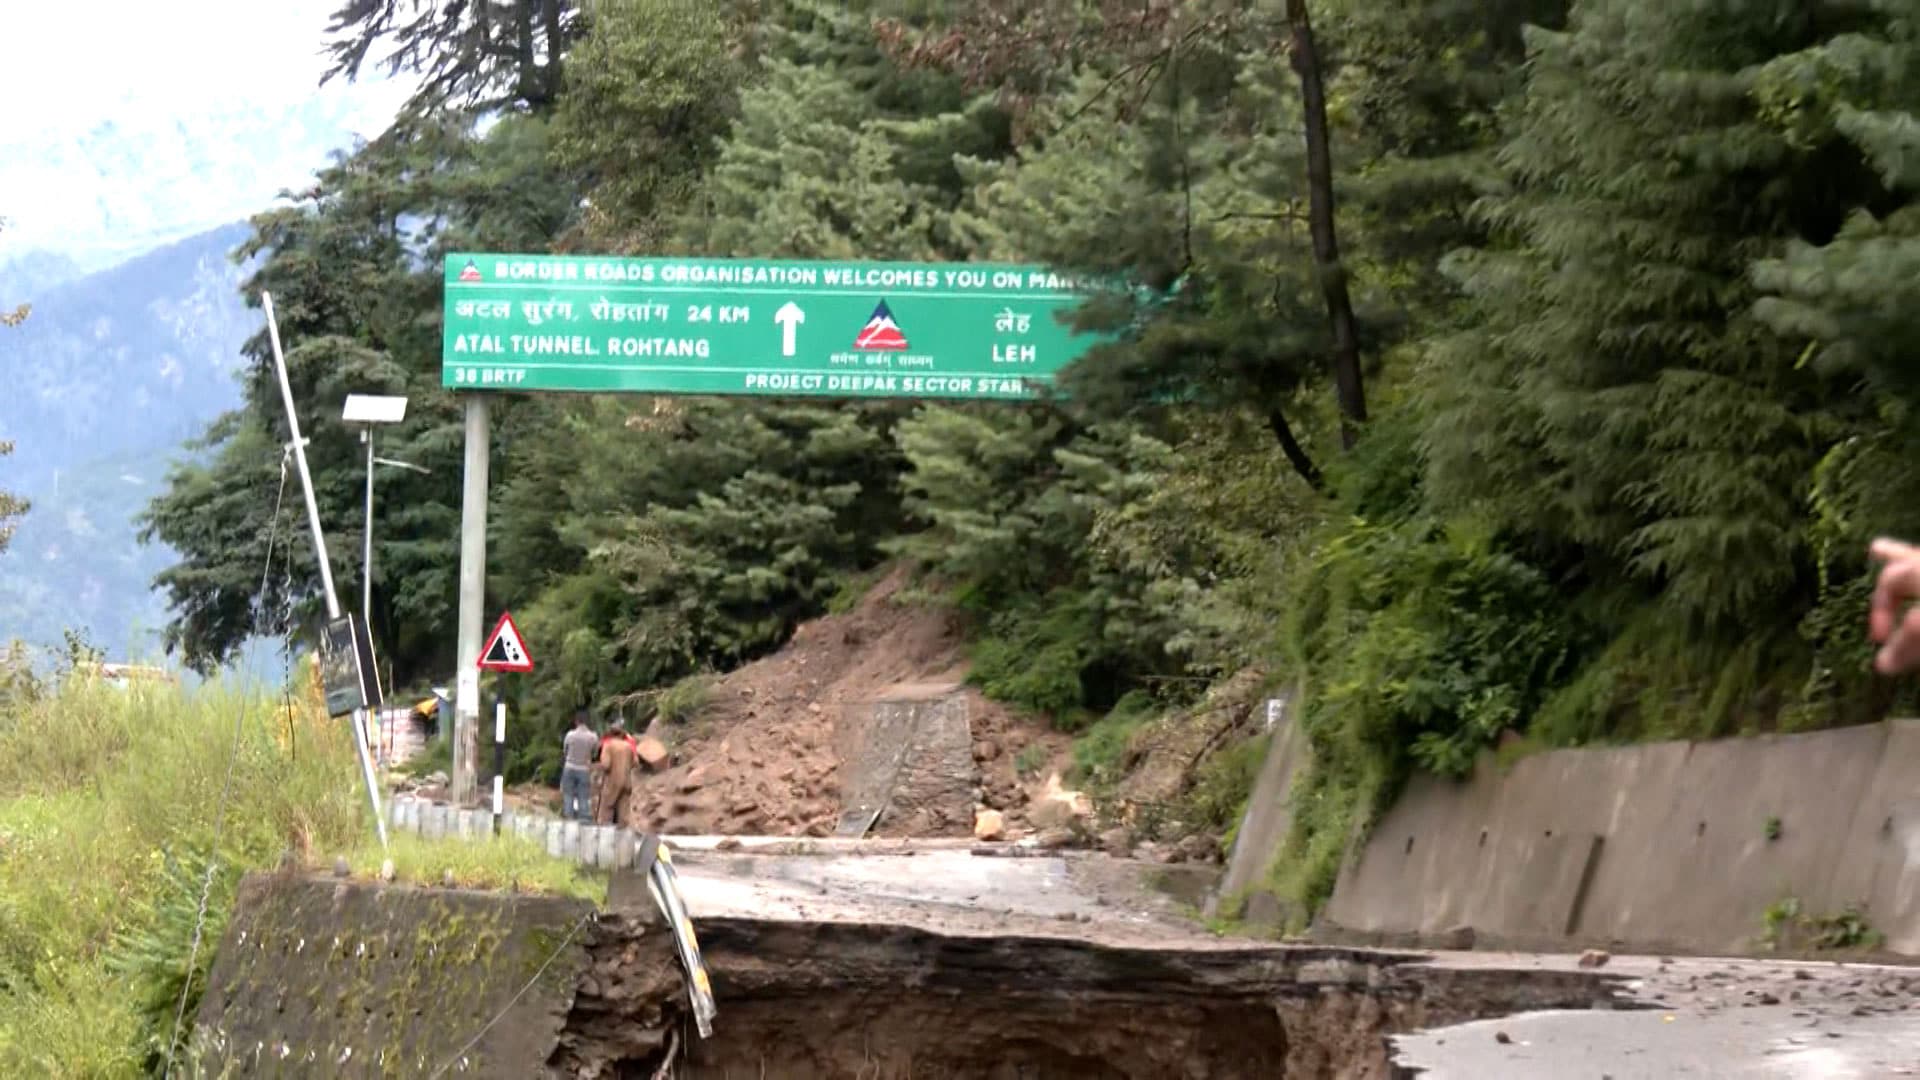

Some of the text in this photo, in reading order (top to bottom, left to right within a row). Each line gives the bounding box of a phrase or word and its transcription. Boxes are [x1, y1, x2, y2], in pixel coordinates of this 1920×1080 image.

[495, 260, 577, 281] BORDER
[584, 263, 654, 284] ROADS
[660, 264, 817, 287] ORGANISATION
[824, 268, 938, 289] WELCOMES
[945, 271, 985, 289] YOU
[992, 272, 1022, 290] ON
[455, 299, 512, 320] अटल
[589, 296, 669, 322] रोहतांग
[687, 305, 712, 322] 24
[719, 307, 749, 323] KM
[996, 308, 1030, 333] लेह
[454, 335, 504, 353] ATAL
[608, 338, 710, 358] ROHTANG
[992, 345, 1036, 363] LEH
[482, 368, 527, 384] BRTF
[745, 373, 823, 390] PROJECT
[829, 374, 896, 391] DEEPAK
[903, 376, 972, 393] SECTOR
